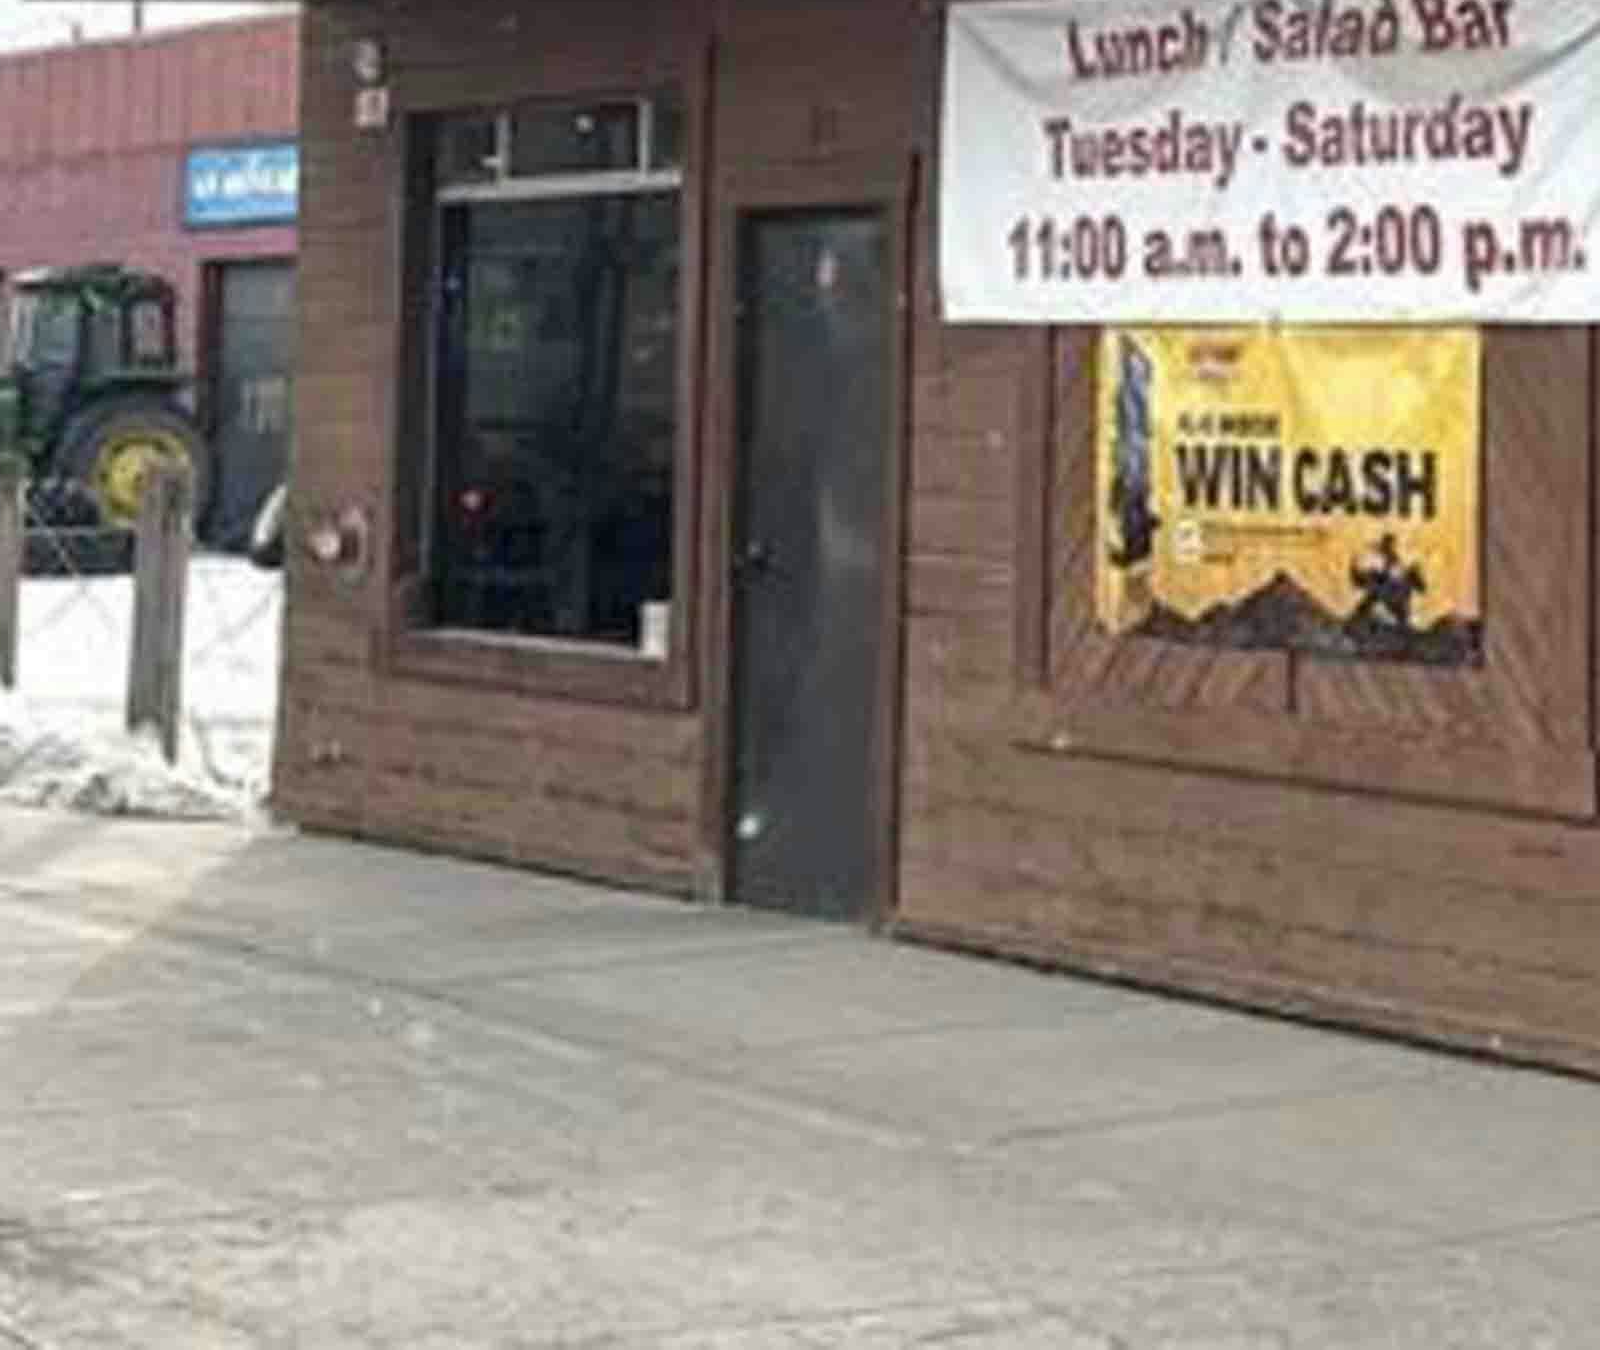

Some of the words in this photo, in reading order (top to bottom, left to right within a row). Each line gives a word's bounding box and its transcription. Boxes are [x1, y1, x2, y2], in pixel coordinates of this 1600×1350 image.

[1066, 6, 1210, 80] Lunch
[1043, 109, 1244, 189] Tuesday
[1282, 93, 1534, 176] Saturday
[1007, 214, 1128, 282] 11:00
[1143, 228, 1244, 279] a.m.
[1260, 212, 1308, 277] to
[1325, 206, 1442, 279] 2:00
[1464, 217, 1589, 293] p.m.
[1174, 442, 1282, 511] WIN
[1292, 446, 1437, 519] CASH
